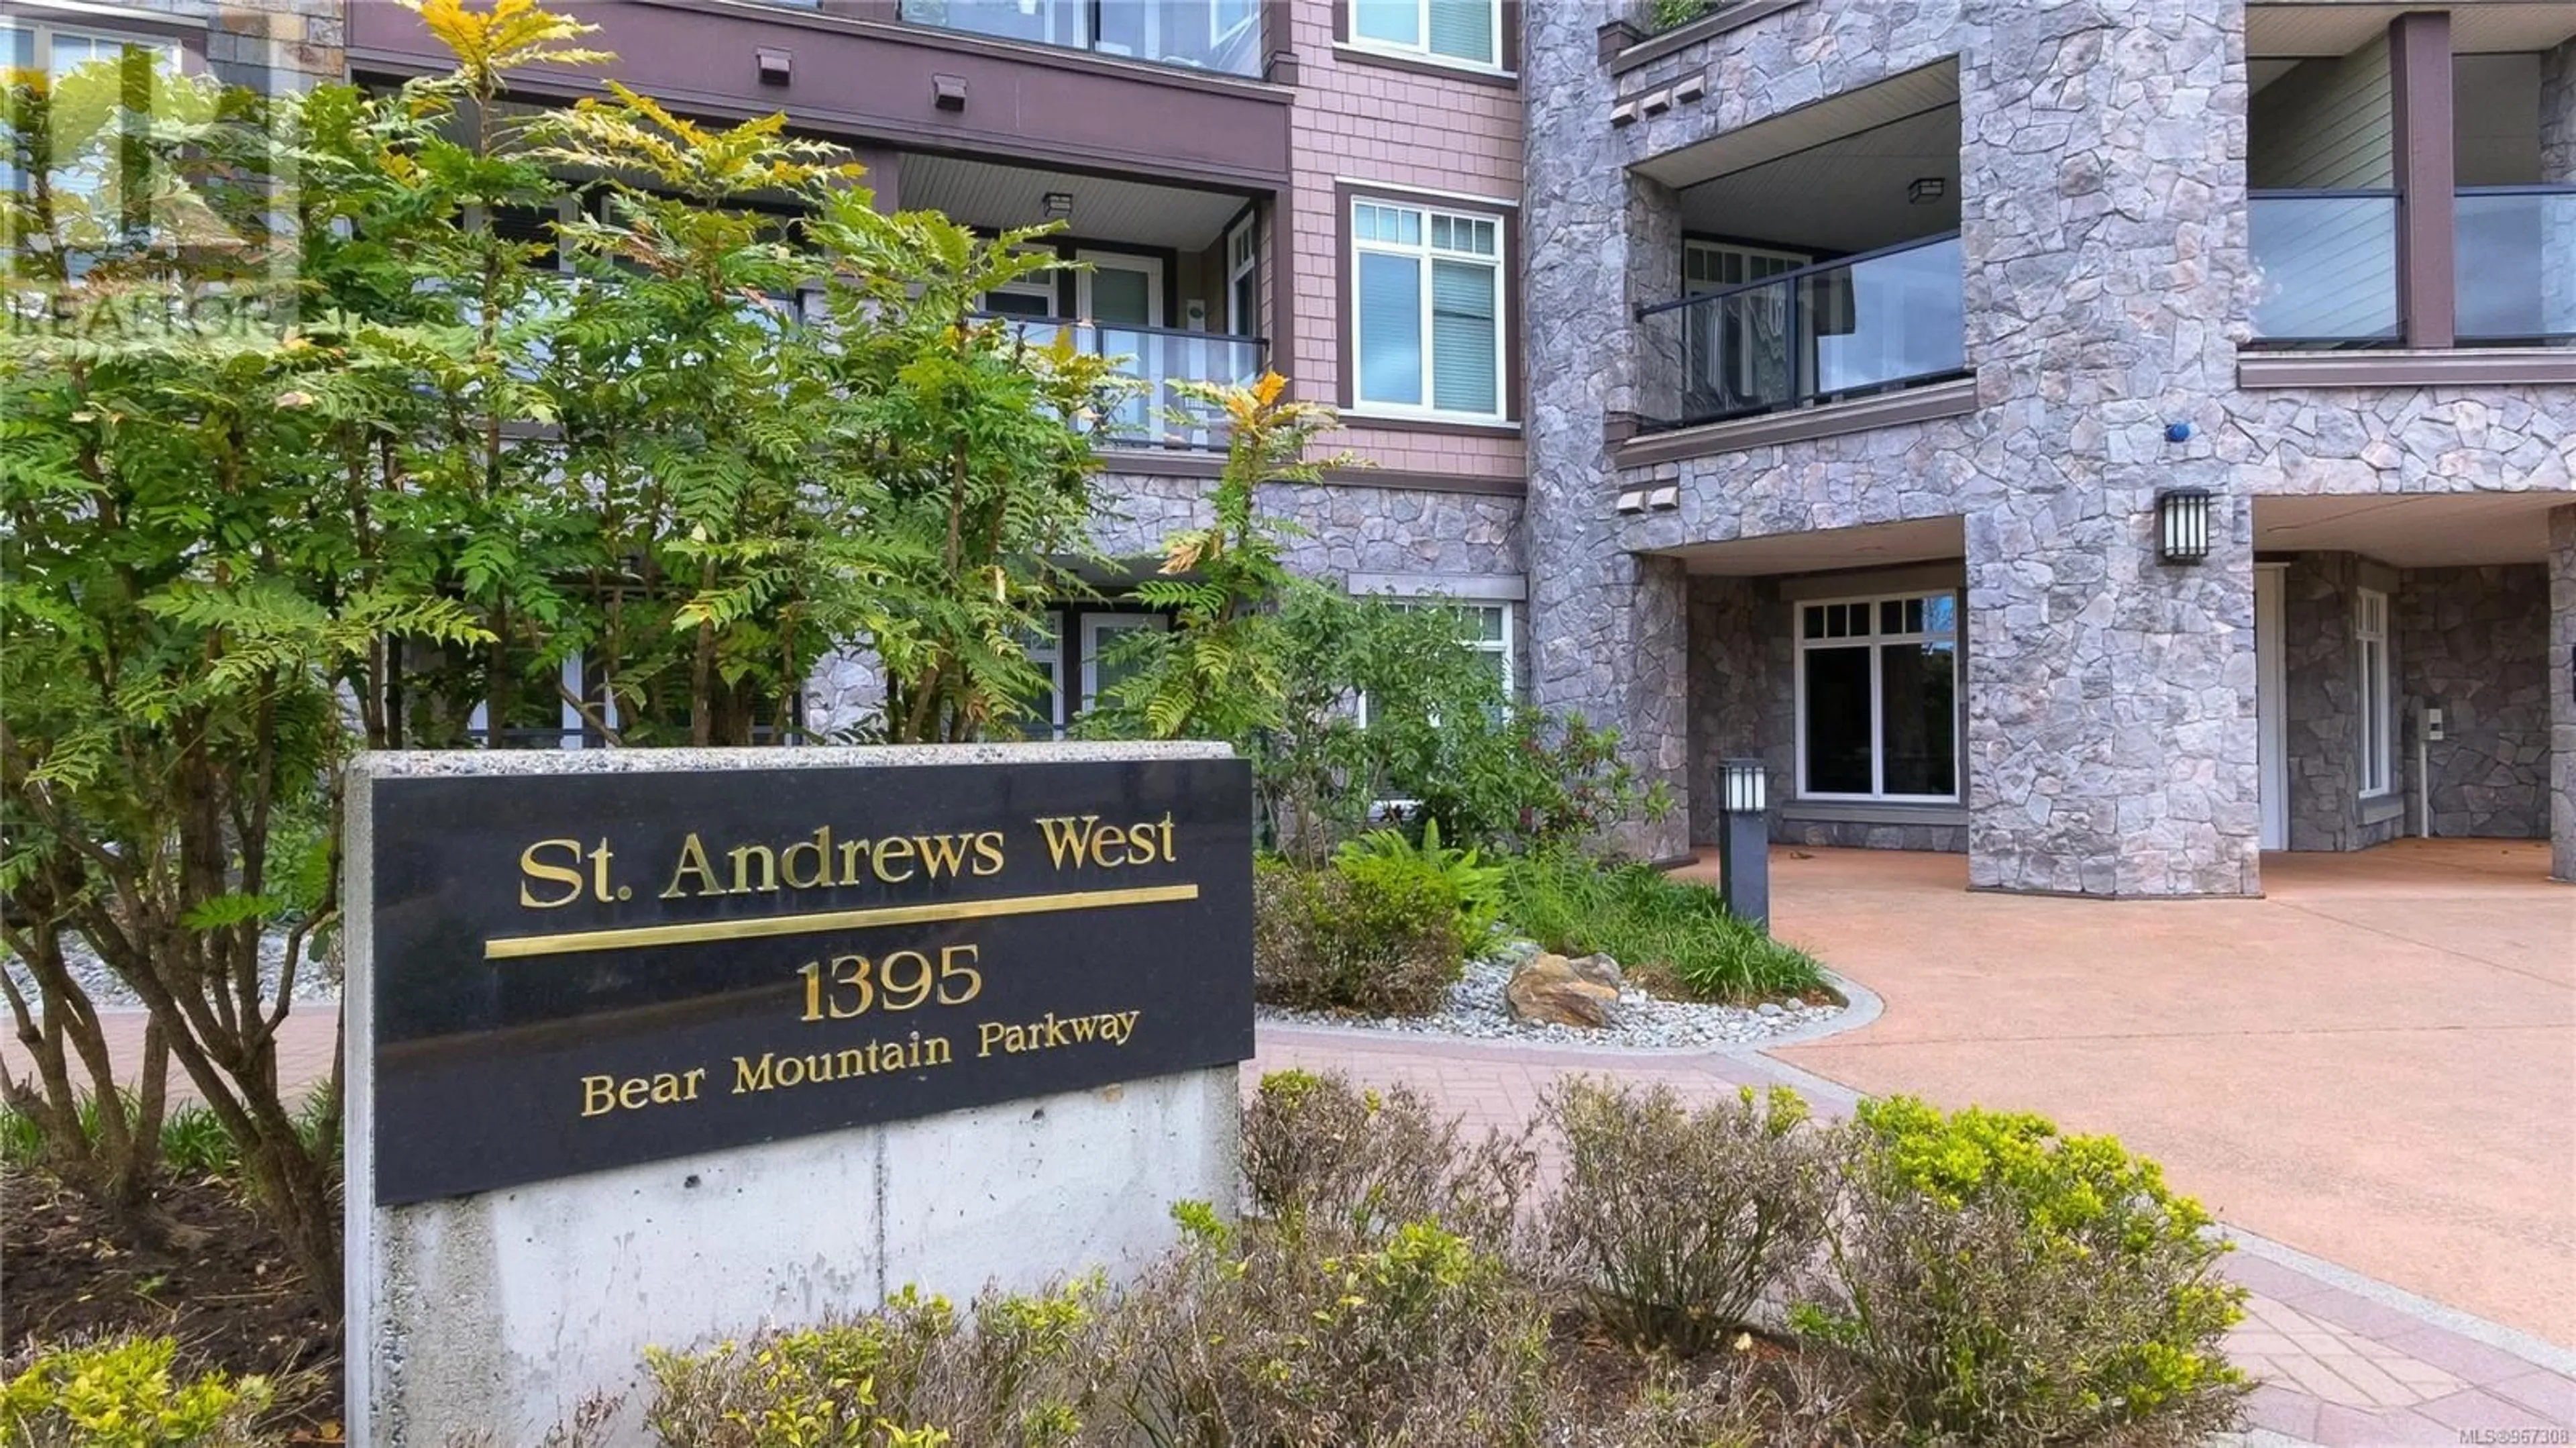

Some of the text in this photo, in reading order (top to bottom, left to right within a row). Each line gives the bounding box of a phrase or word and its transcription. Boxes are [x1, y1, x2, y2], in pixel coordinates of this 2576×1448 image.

[519, 811, 1178, 909] St. Andrews West
[796, 943, 983, 1022] 1395
[580, 1011, 1142, 1118] Bear Mountain Parkway
